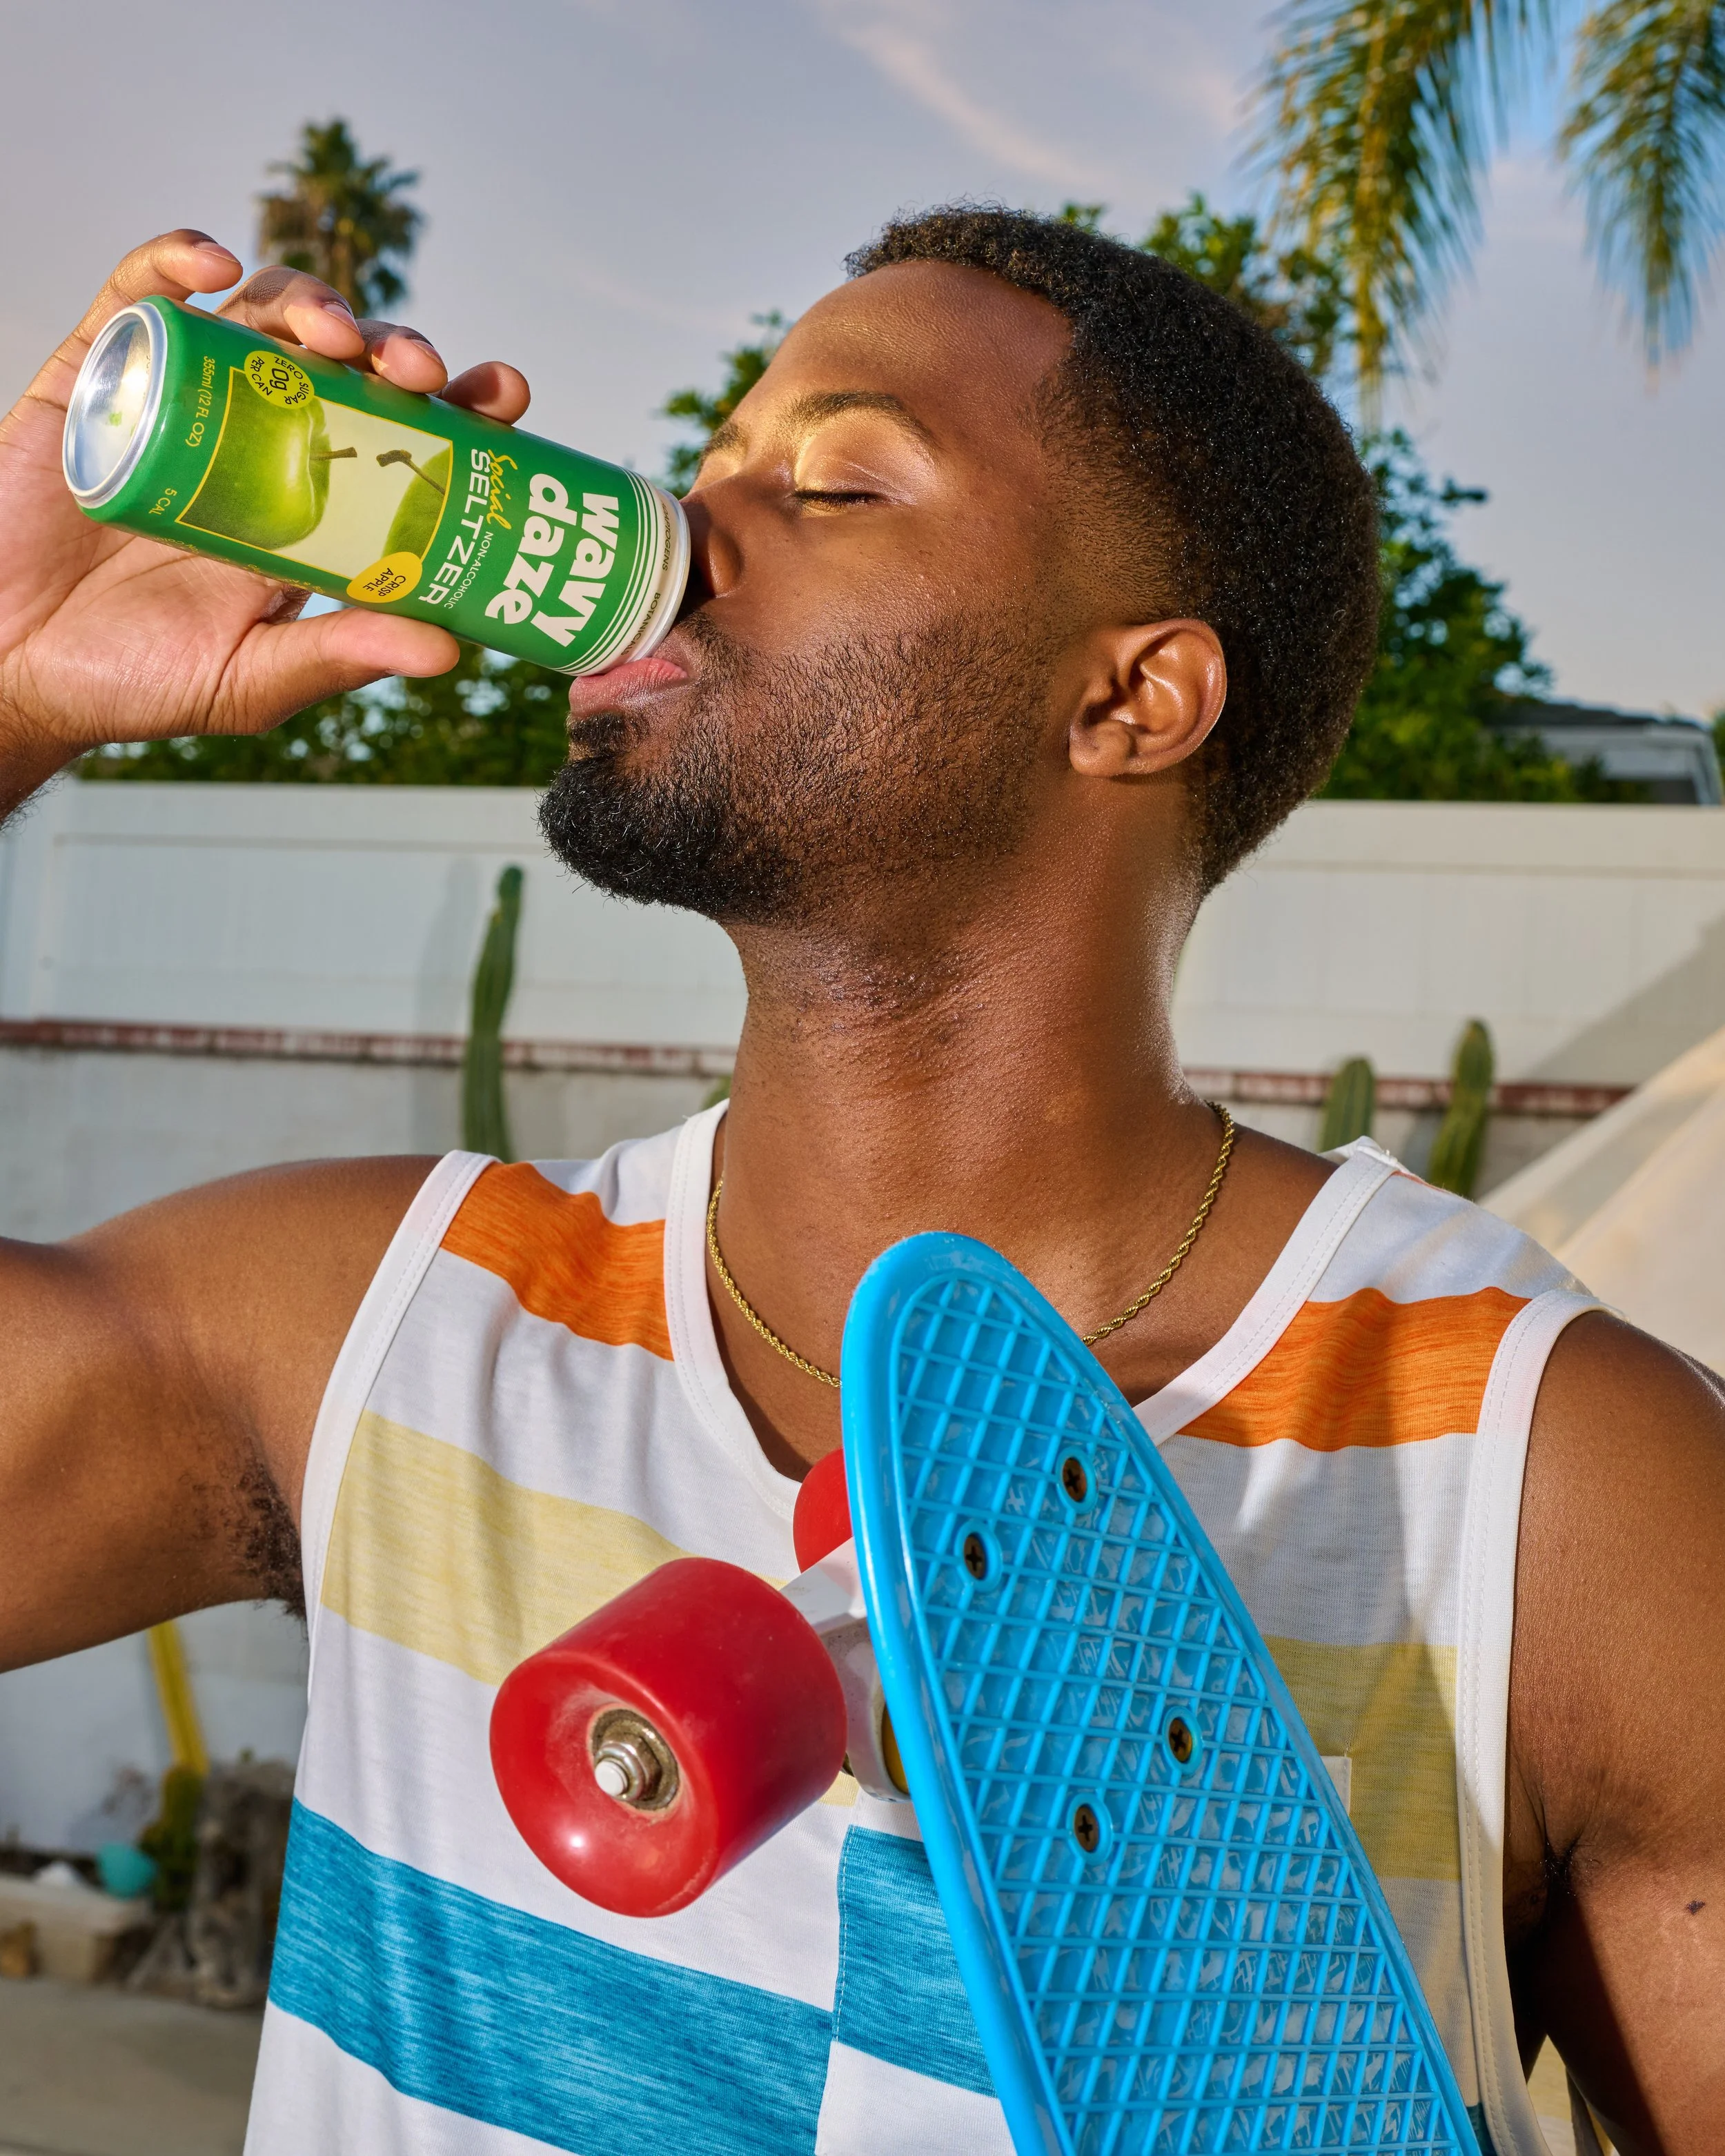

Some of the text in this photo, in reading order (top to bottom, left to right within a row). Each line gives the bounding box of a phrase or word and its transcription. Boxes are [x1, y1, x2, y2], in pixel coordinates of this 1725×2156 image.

[185, 356, 215, 447] 355ml (12 FL OZ)
[250, 356, 309, 405] ZERO SUGAR PER CAN
[148, 488, 178, 515] 5 CAL
[418, 448, 491, 604] SELTZER
[486, 449, 518, 530] Social
[362, 567, 394, 592] APPLE
[378, 575, 406, 597] CRISP
[444, 531, 494, 609] NON-ALCOHOLIC
[484, 473, 578, 624] daze
[530, 492, 620, 648] wavy
[620, 592, 661, 655] BOTANICALS
